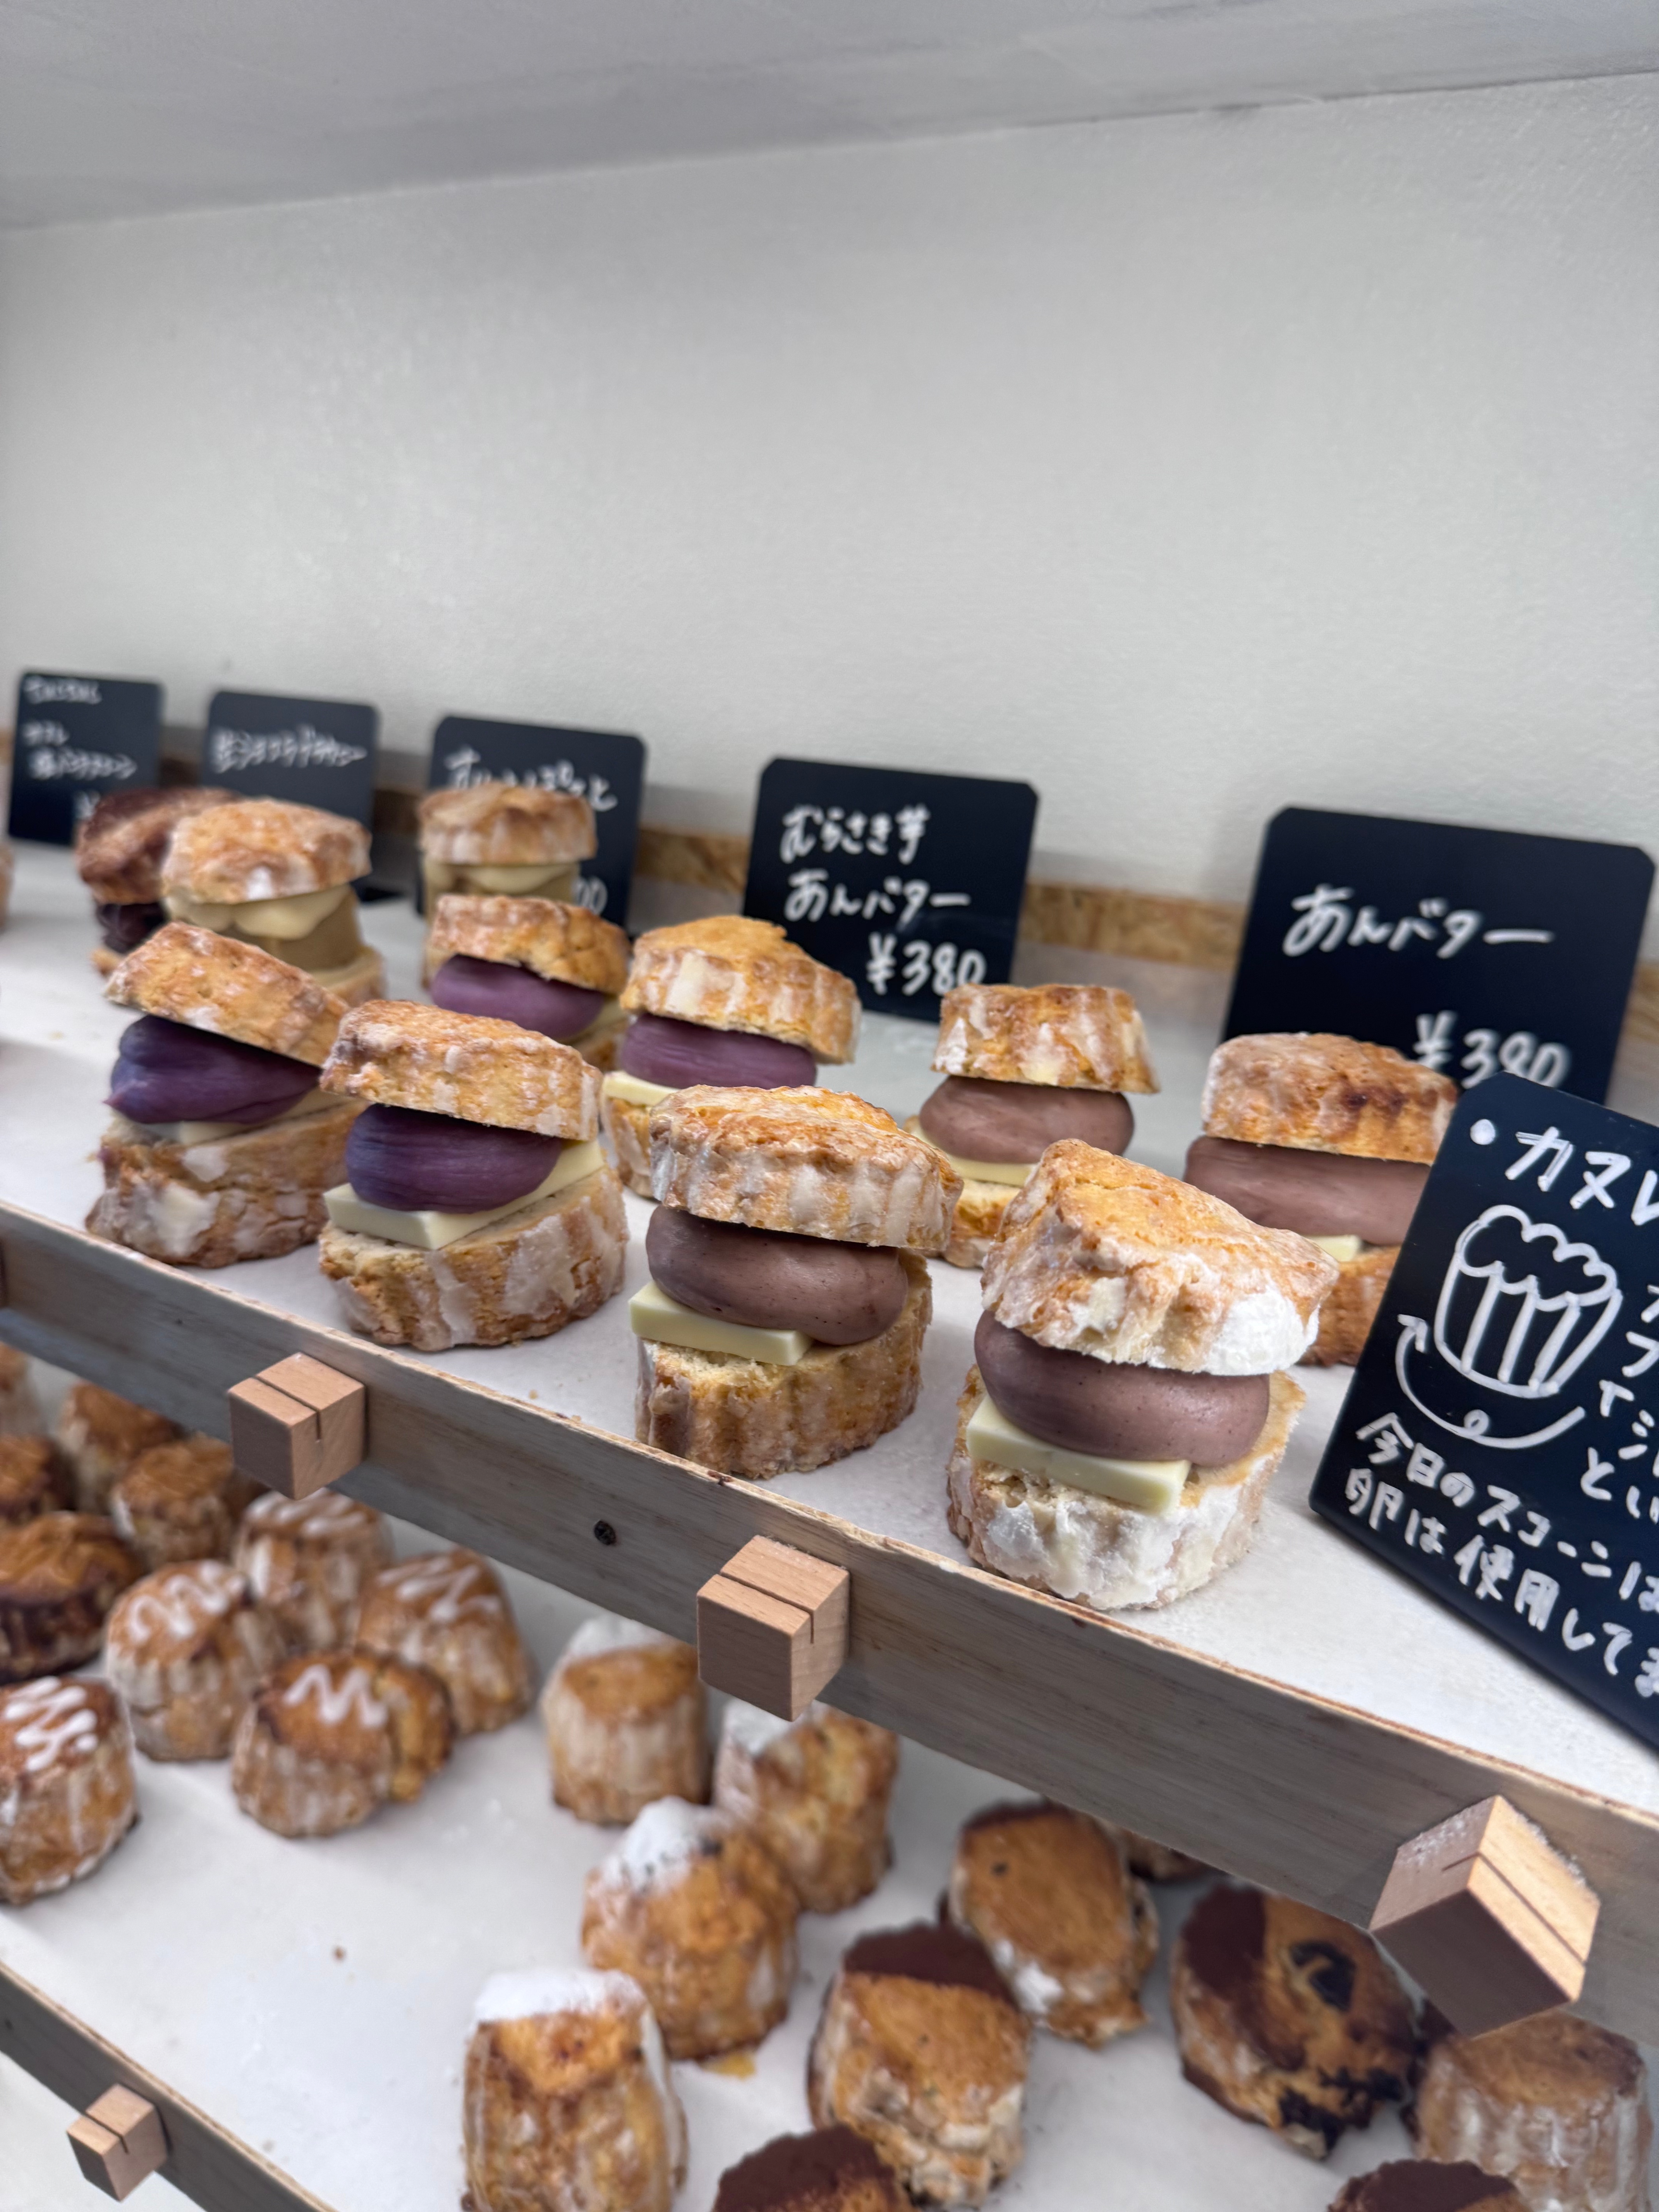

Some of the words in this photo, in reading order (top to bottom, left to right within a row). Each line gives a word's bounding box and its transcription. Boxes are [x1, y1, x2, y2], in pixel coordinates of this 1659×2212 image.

[780, 804, 930, 864] むらさき芋
[784, 869, 970, 924] あんバター
[1282, 884, 1554, 958] あんバター
[866, 933, 987, 996] ¥380
